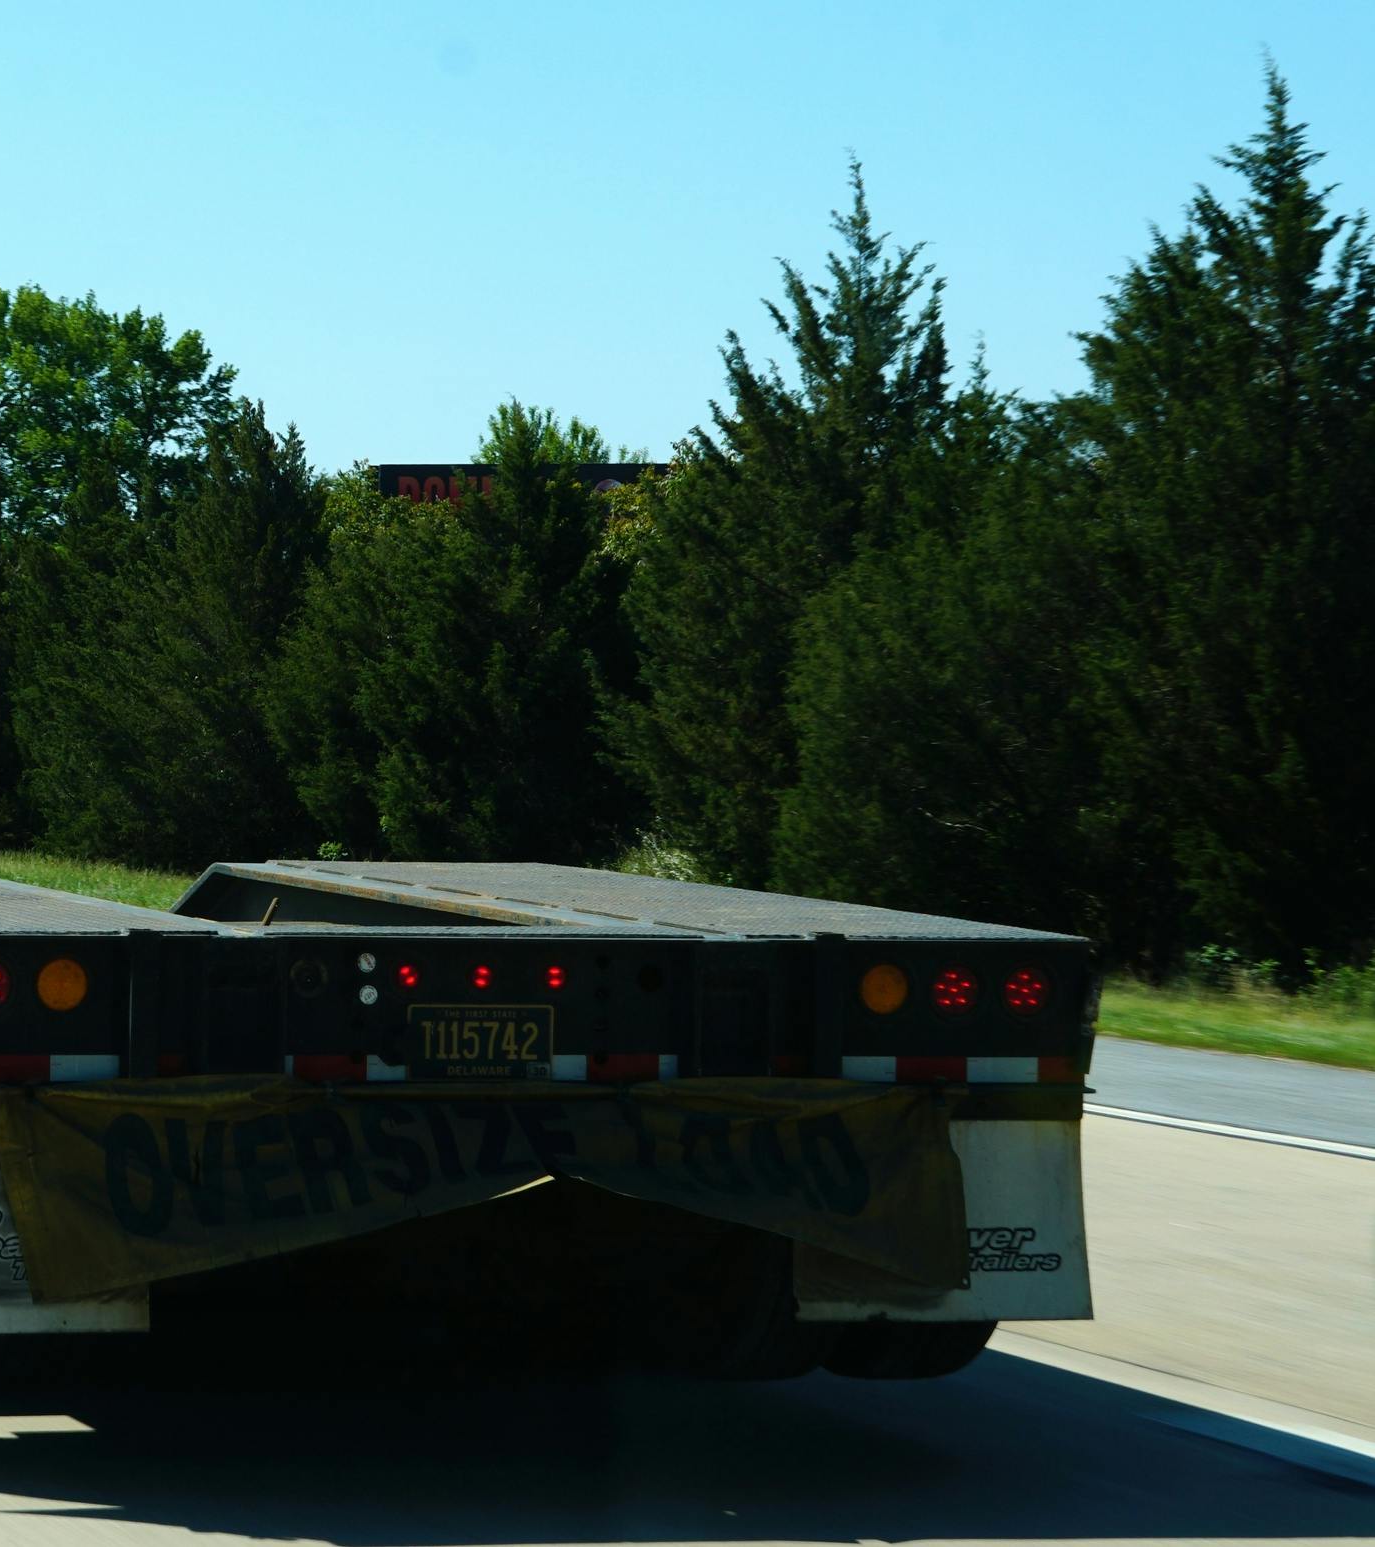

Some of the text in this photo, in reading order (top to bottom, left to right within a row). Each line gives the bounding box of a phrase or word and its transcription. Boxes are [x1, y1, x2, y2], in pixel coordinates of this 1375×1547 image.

[492, 1010, 517, 1018] STATE
[421, 1020, 539, 1060] T115742
[447, 1065, 512, 1077] DELAWARE
[105, 1098, 577, 1236] OVERSIZE
